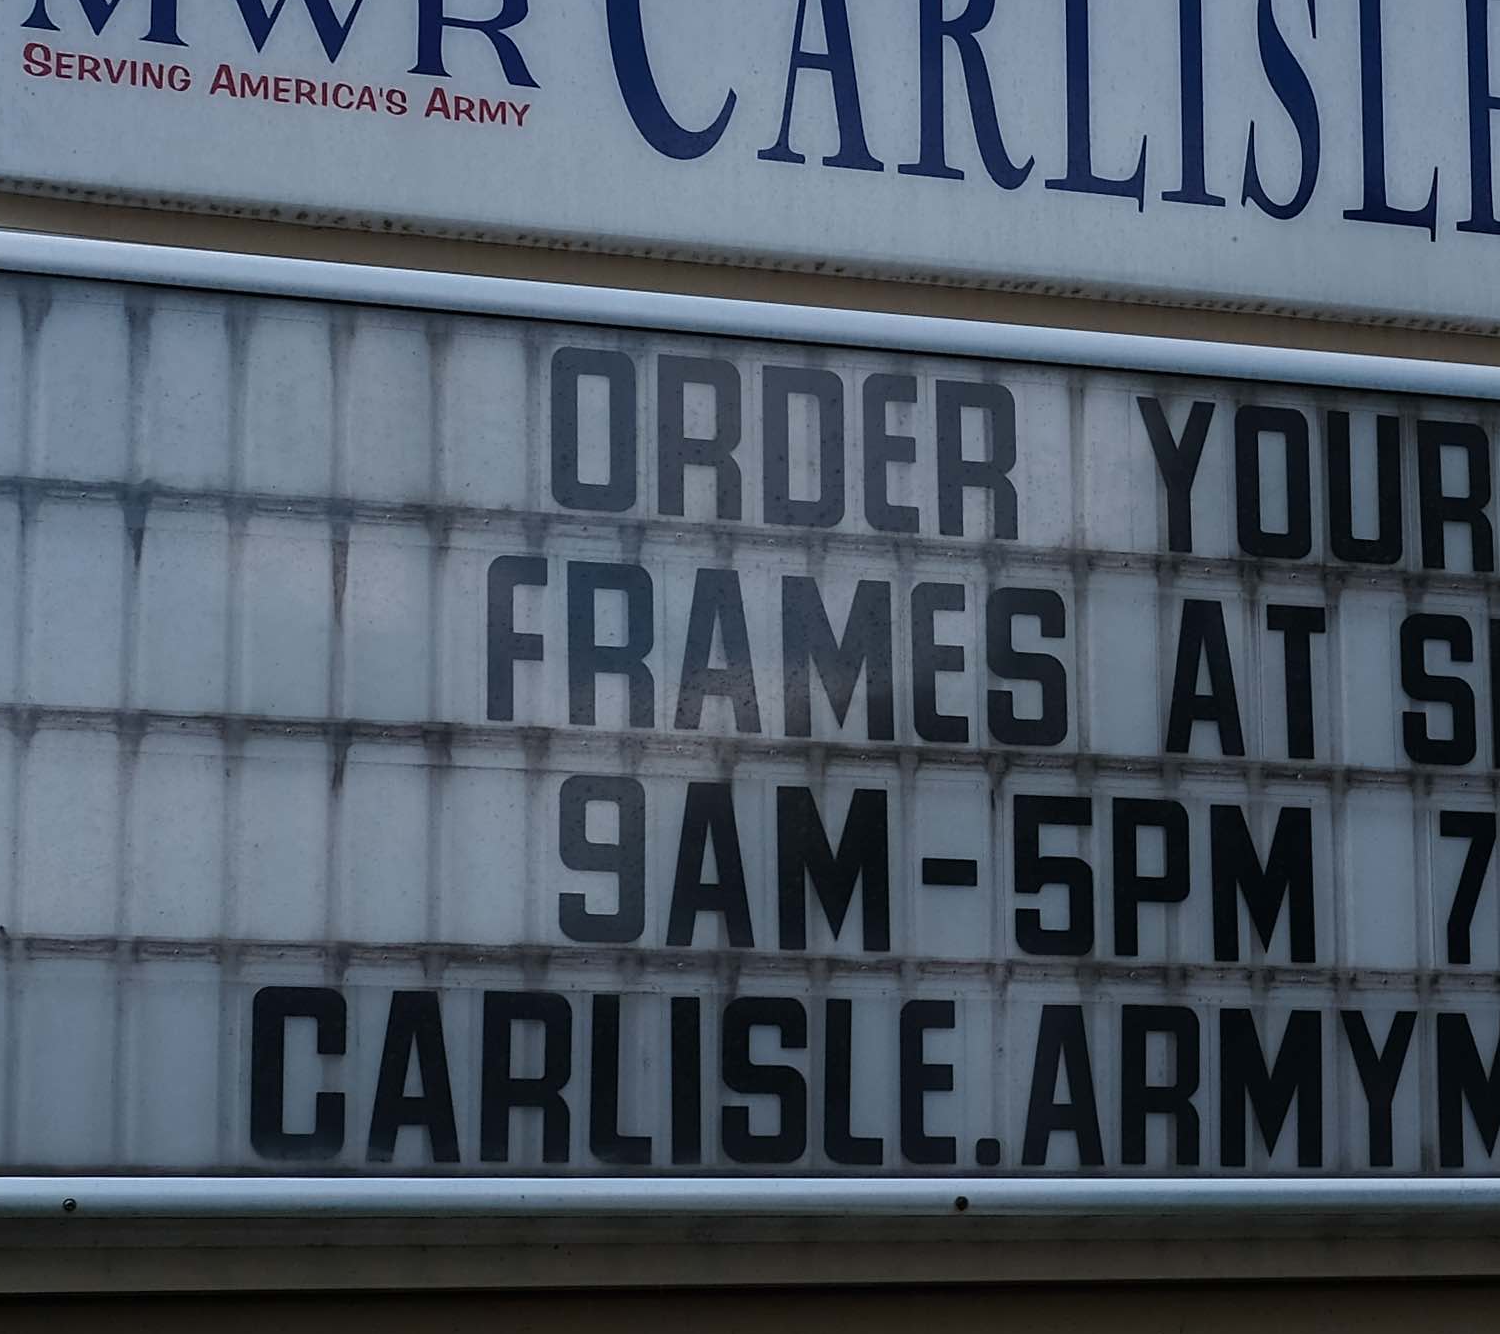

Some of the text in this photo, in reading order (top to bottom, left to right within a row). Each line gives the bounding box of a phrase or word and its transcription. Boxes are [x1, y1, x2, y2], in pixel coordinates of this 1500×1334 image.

[22, 42, 532, 127] SERVING AMERICA'S ARMY
[550, 346, 1018, 541] ORDER
[1136, 396, 1494, 574] YOUR
[486, 555, 1069, 747] FRAMES
[1164, 598, 1327, 760] AT
[558, 775, 1316, 965] 9AM-5PM
